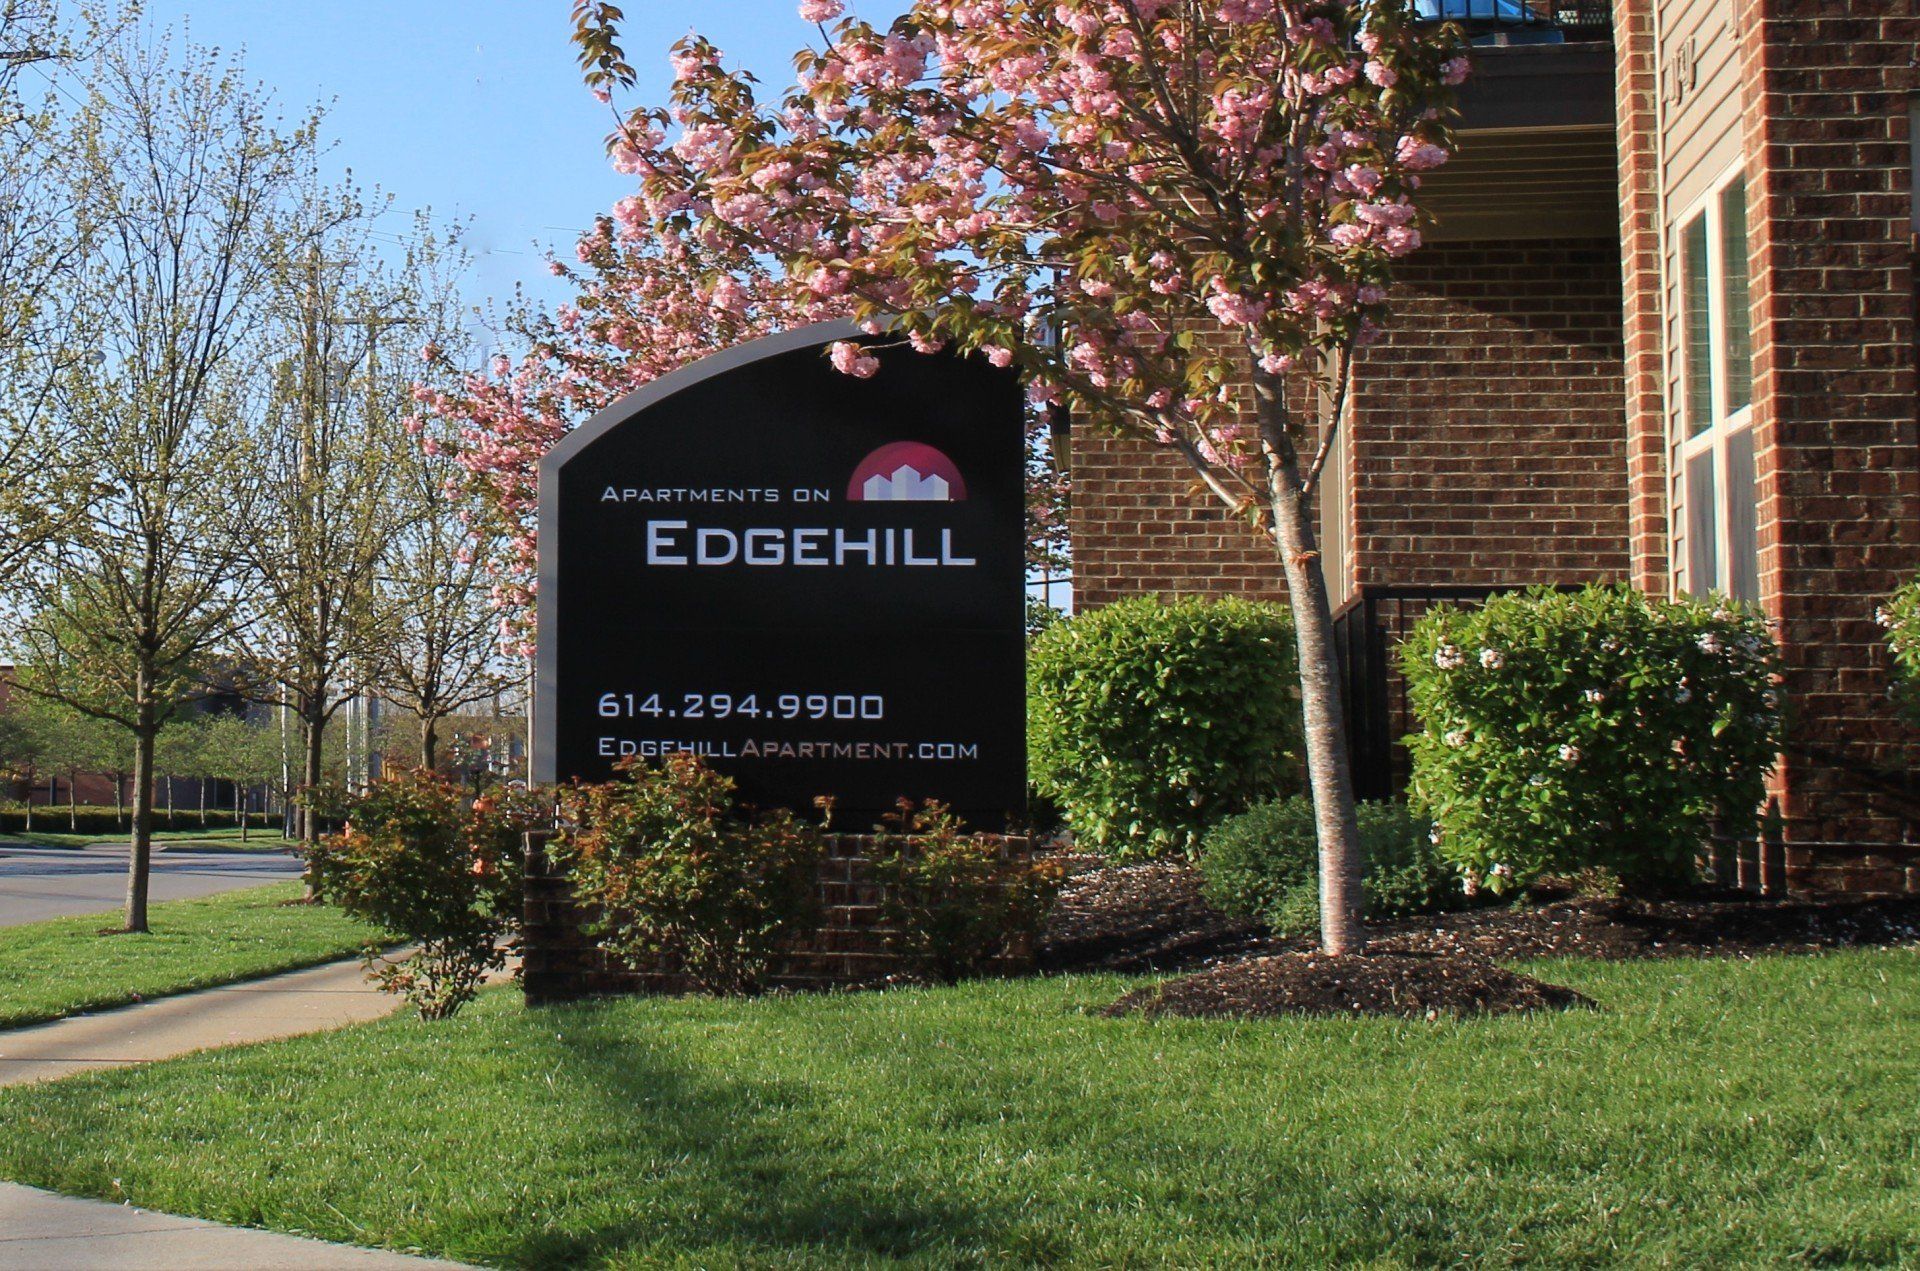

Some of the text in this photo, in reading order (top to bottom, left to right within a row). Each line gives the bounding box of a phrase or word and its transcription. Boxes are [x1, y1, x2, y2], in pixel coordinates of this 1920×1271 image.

[600, 485, 830, 502] APARTMENTS ON
[646, 520, 977, 566] EDGEHILL
[598, 693, 884, 719] 614.294.9900
[598, 736, 979, 759] EDGEHILLAPARTMENT.COM
